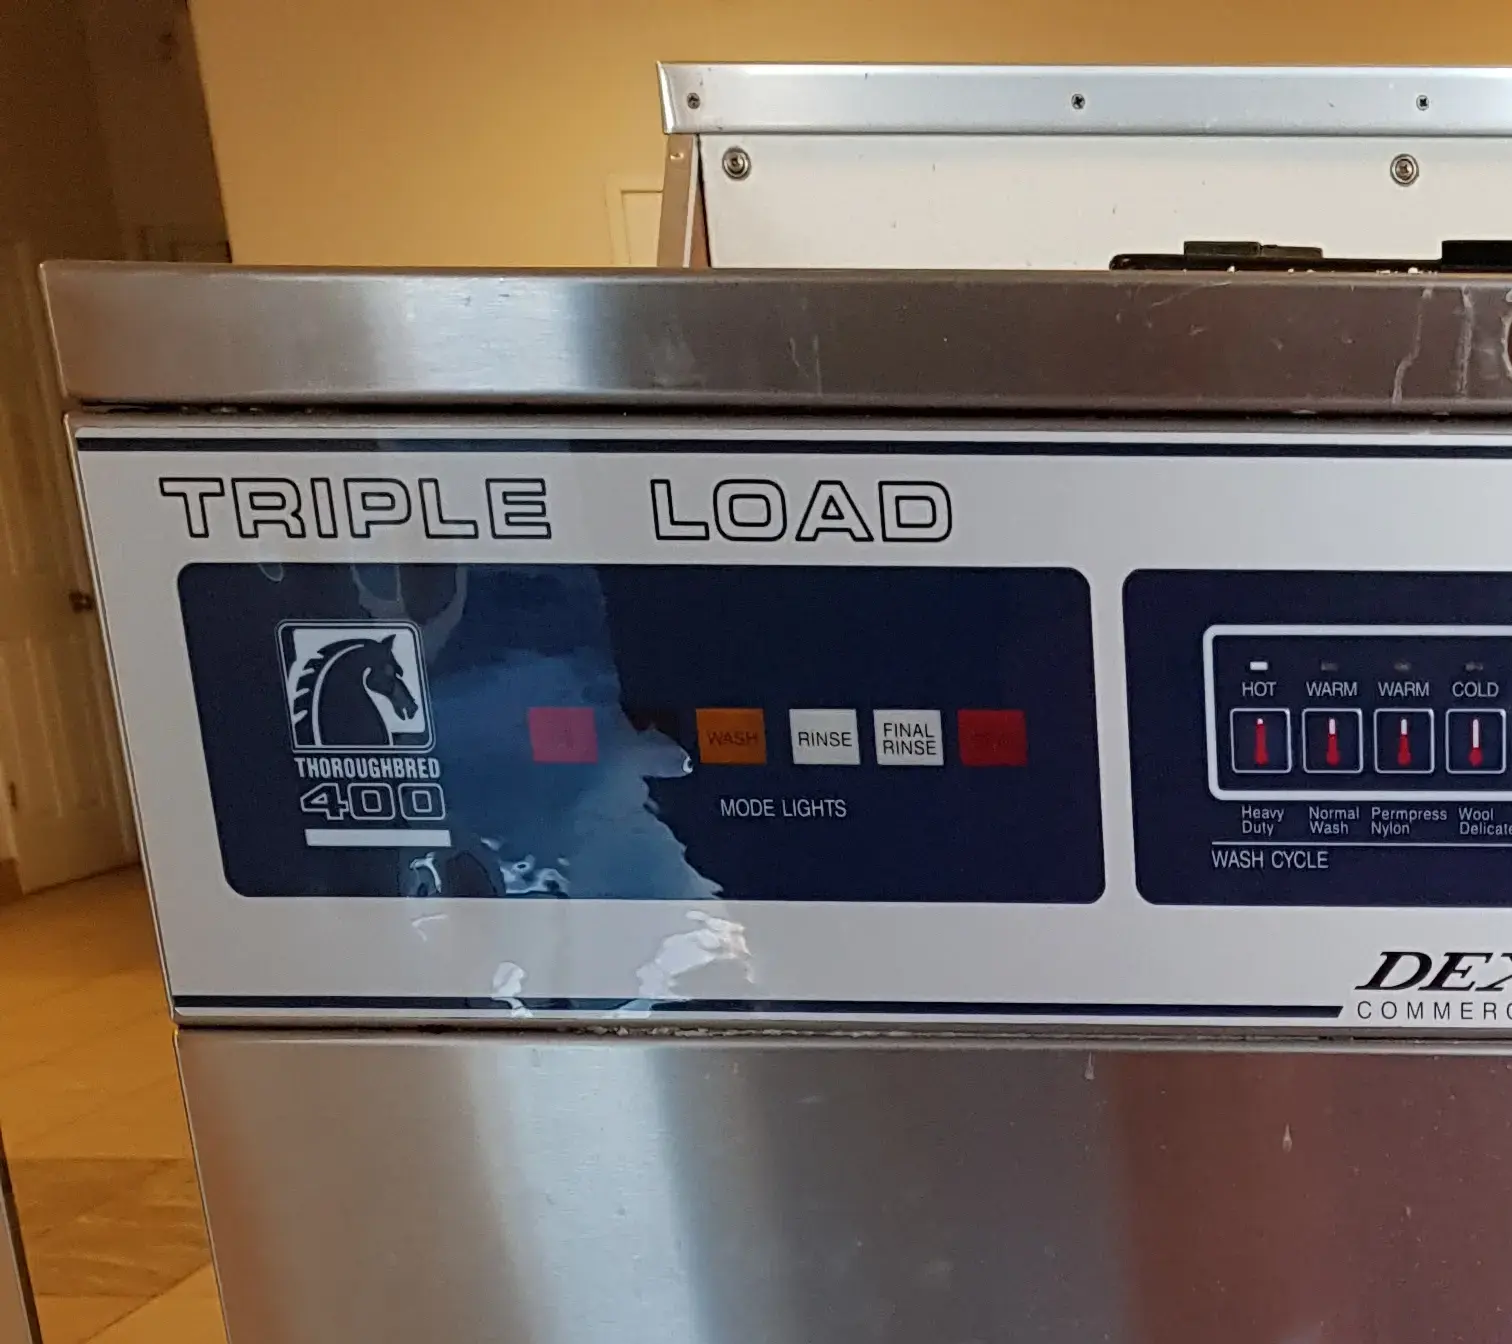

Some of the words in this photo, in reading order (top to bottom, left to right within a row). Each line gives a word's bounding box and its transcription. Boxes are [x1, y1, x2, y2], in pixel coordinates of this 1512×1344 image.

[160, 476, 552, 541] TRIPLE
[650, 479, 953, 543] LOAD
[1242, 681, 1277, 698] HOT
[1305, 681, 1358, 698] WARM
[1377, 681, 1430, 698] WARM
[1452, 682, 1499, 699] COLD
[883, 722, 936, 738] FINAL
[707, 731, 758, 747] WASH
[798, 731, 852, 747] RINSE
[883, 739, 937, 756] RINSE
[294, 757, 440, 779] THOROUGHBRED
[300, 783, 446, 820] 400
[720, 799, 775, 817] MODE
[782, 799, 847, 818] LIGHTS
[1241, 806, 1285, 822] Heavy
[1309, 806, 1360, 820] Normal
[1371, 806, 1447, 823] Permpress
[1459, 807, 1494, 821] Wool
[1242, 820, 1274, 836] Duty
[1309, 821, 1349, 835] Wash
[1371, 822, 1410, 838] Nylon
[1212, 851, 1264, 868] WASH
[1271, 851, 1329, 869] CYCLE
